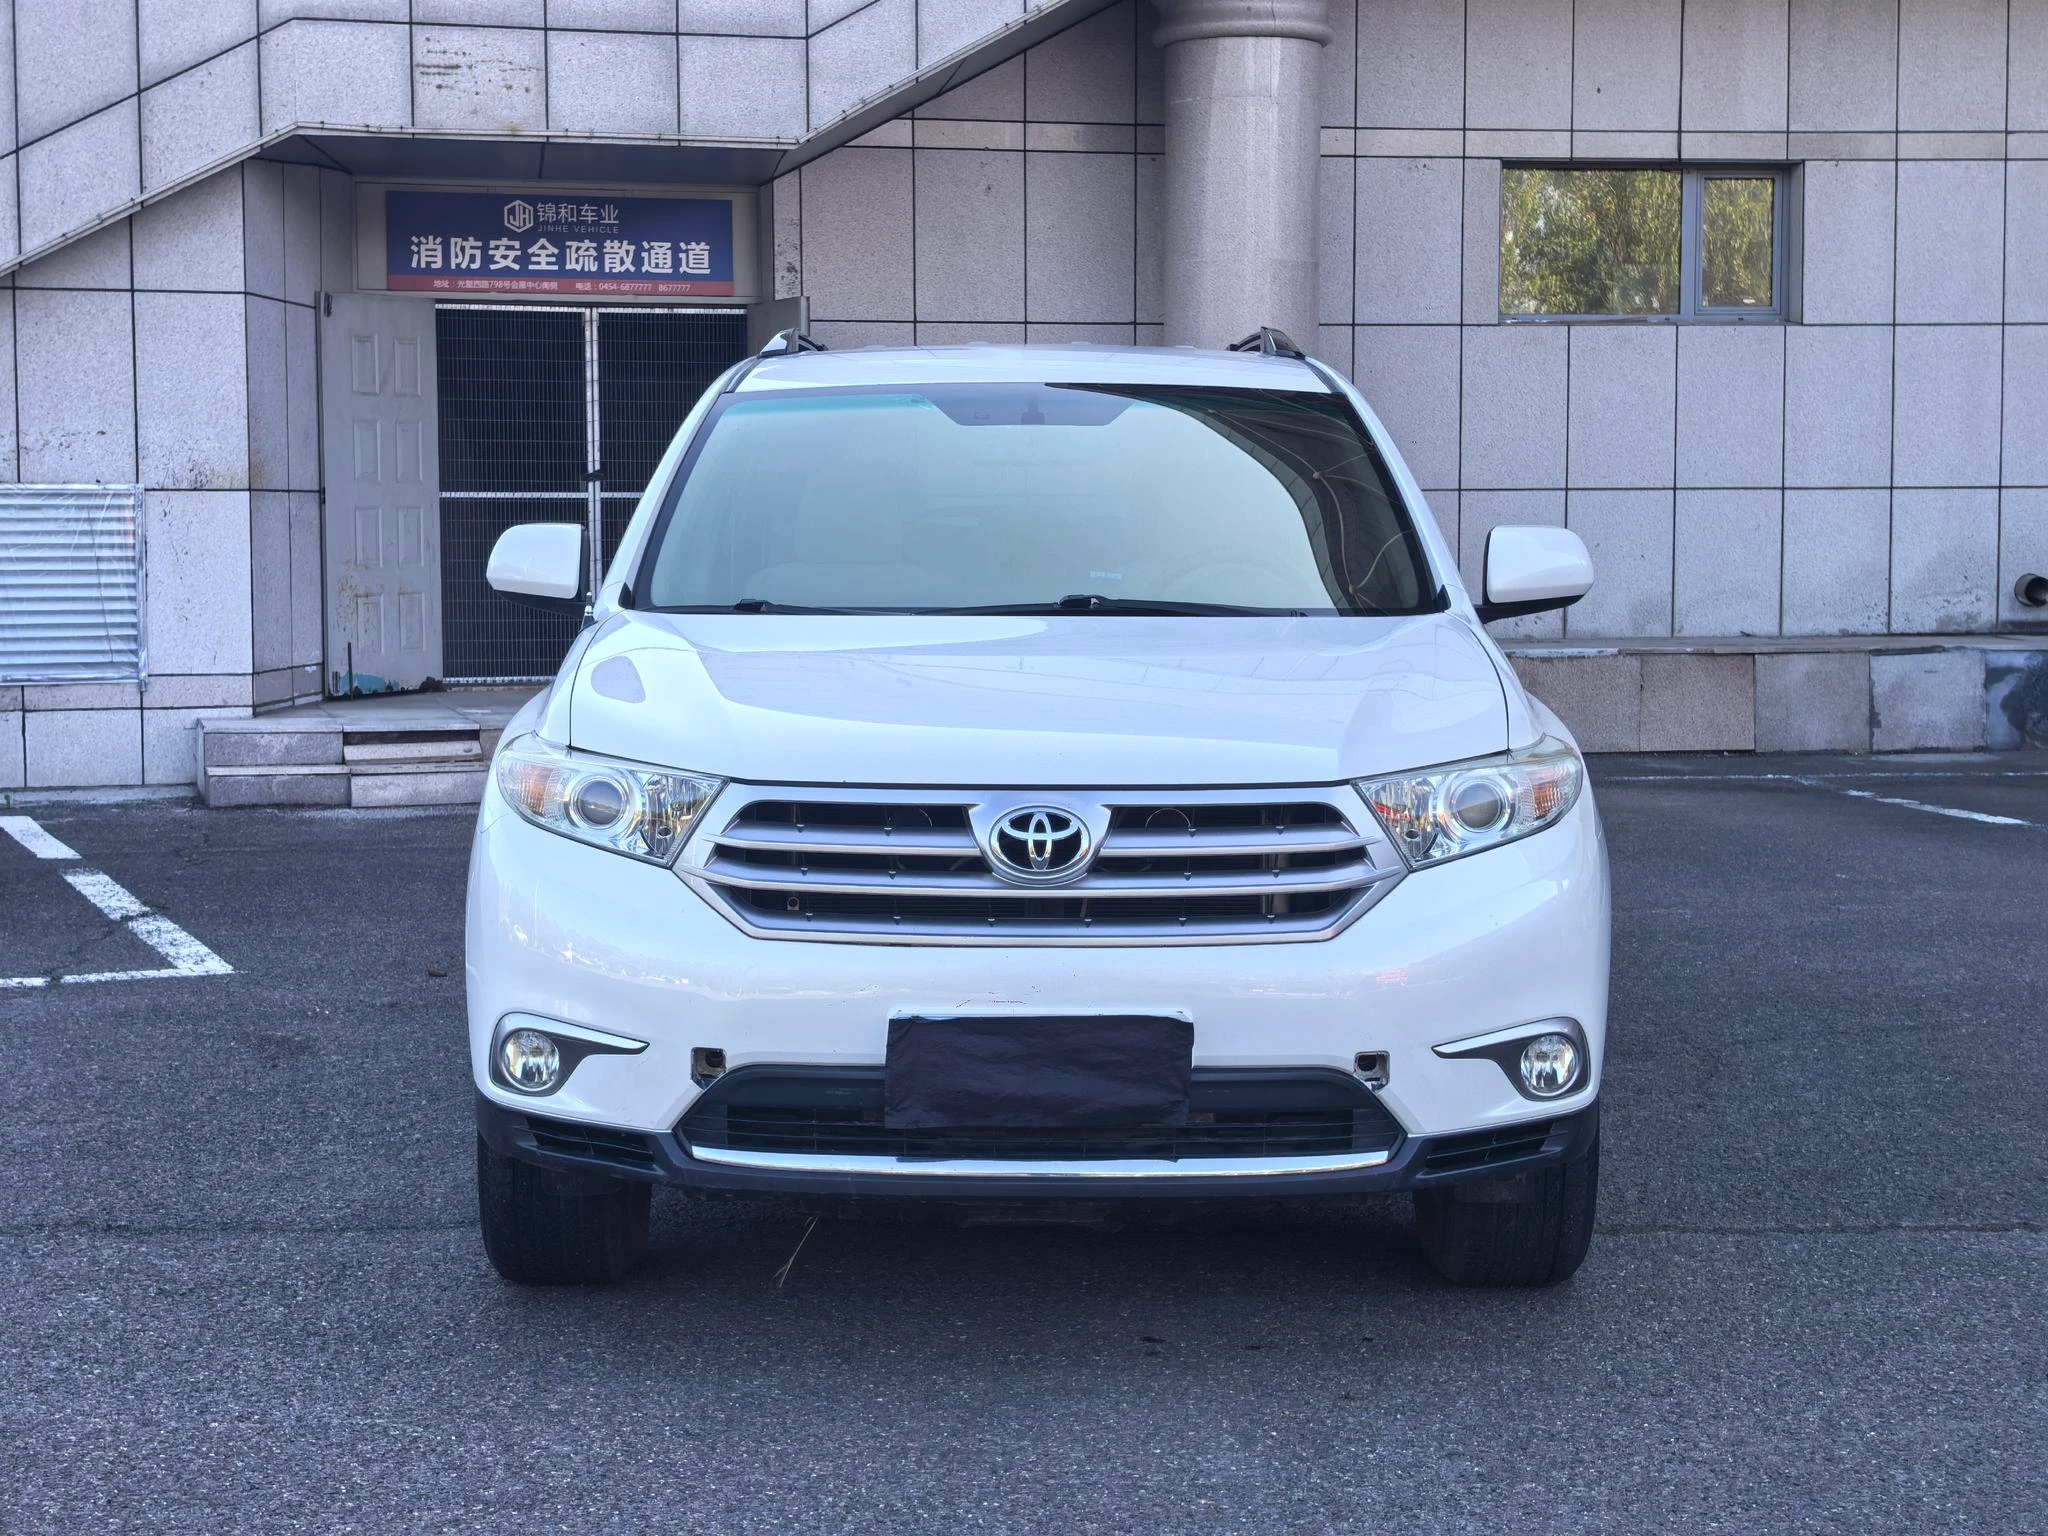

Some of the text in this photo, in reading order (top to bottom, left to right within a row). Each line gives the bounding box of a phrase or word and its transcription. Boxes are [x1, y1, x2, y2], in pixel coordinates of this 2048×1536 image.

[536, 202, 620, 224] 锦和车业
[537, 224, 620, 235] JINHE VEHICLE
[410, 235, 711, 274] 消防安全疏散通道
